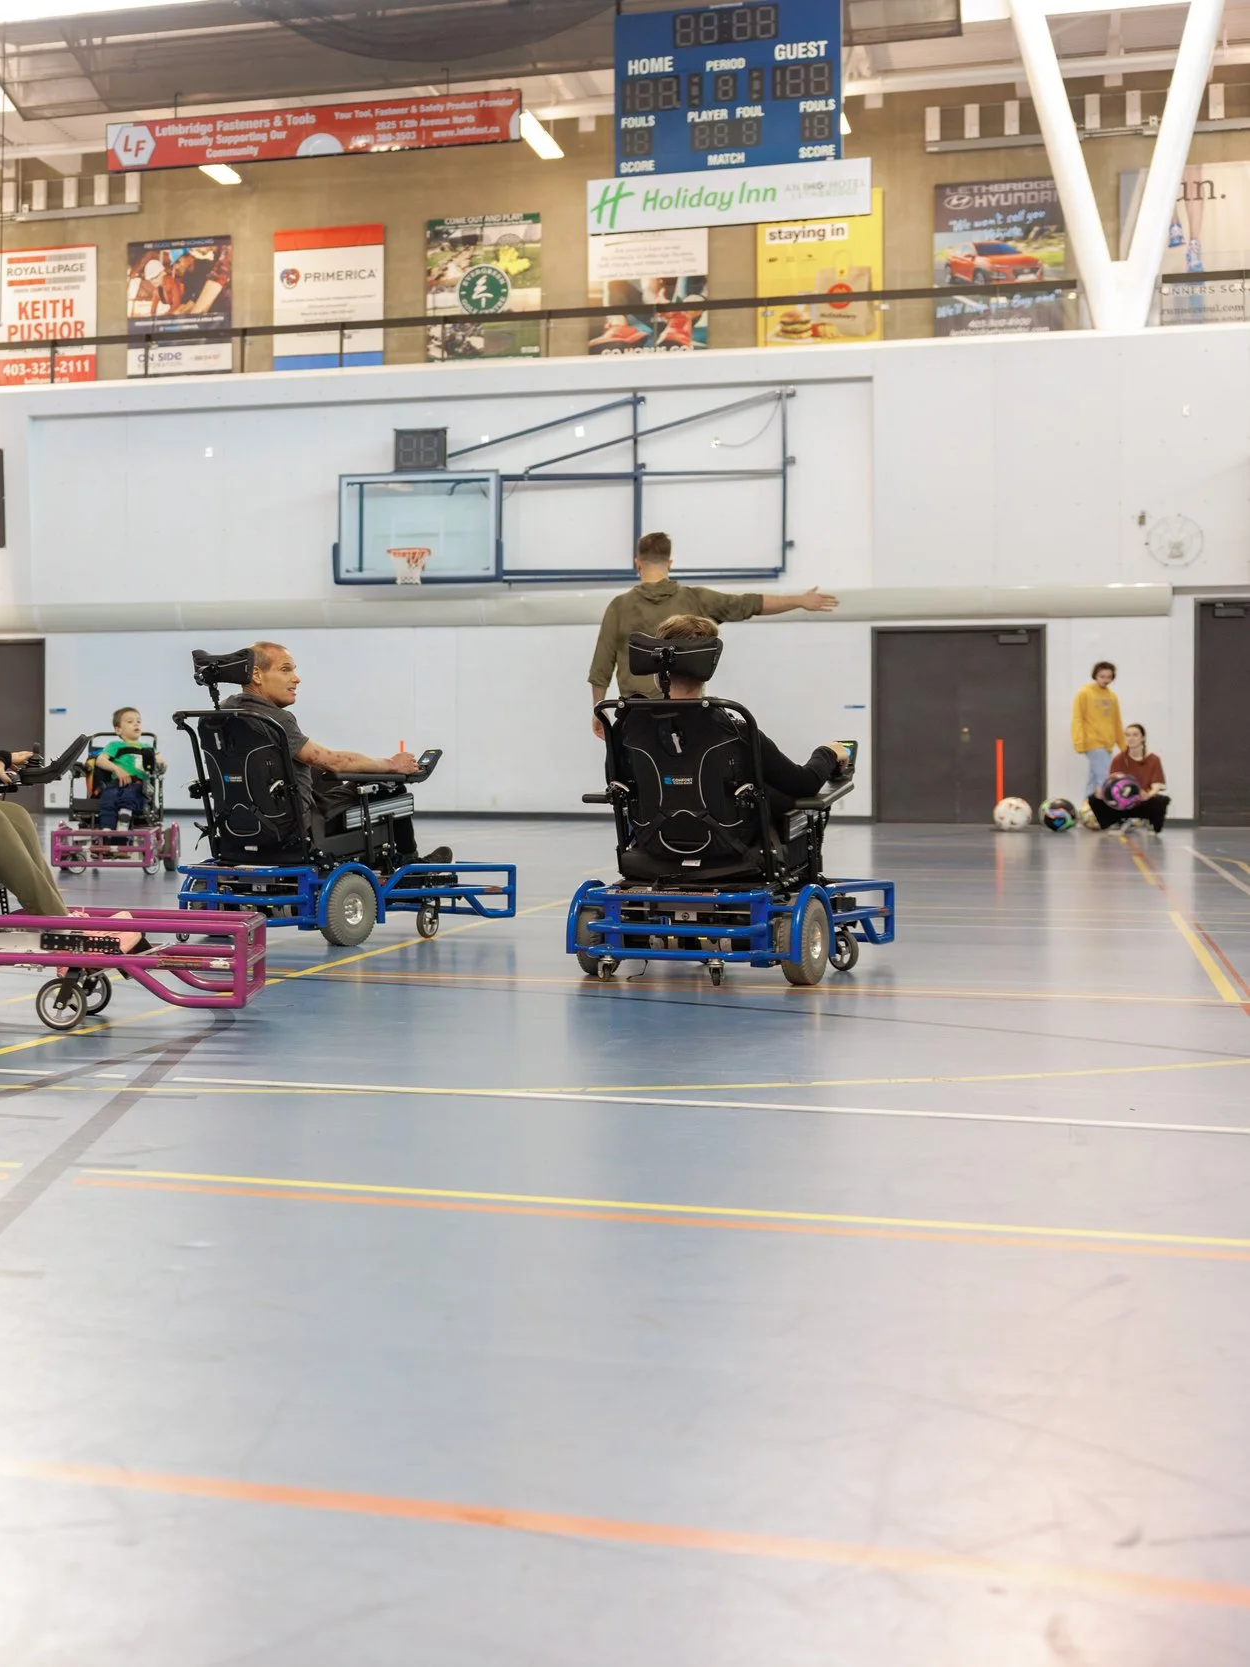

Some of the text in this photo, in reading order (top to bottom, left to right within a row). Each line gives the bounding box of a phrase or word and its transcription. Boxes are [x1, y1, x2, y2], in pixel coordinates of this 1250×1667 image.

[774, 40, 829, 61] GUEST
[627, 56, 674, 76] HOME
[706, 57, 746, 72] PERIOD
[799, 99, 836, 113] FOULS
[687, 105, 765, 123] PLAYER FOUL
[155, 113, 316, 137] Lethbridge Fasteners & Tools
[621, 115, 656, 129] FOULS
[178, 130, 287, 148] Proudly Supporting Our
[205, 145, 259, 159] Community
[707, 152, 746, 166] MATCH
[798, 144, 836, 159] SCORE
[620, 160, 656, 174] SCORE
[945, 180, 1057, 195] LETHBRIDGE
[641, 181, 777, 212] Holiday Inn
[974, 190, 1059, 208] HYUNDAI
[484, 214, 501, 222] AND
[1026, 210, 1046, 224] you
[768, 223, 846, 242] staying in
[6, 265, 45, 277] ROYAL
[303, 268, 377, 284] PRIMERICA
[17, 298, 75, 321] KEITH
[6, 320, 86, 343] PUSHOR
